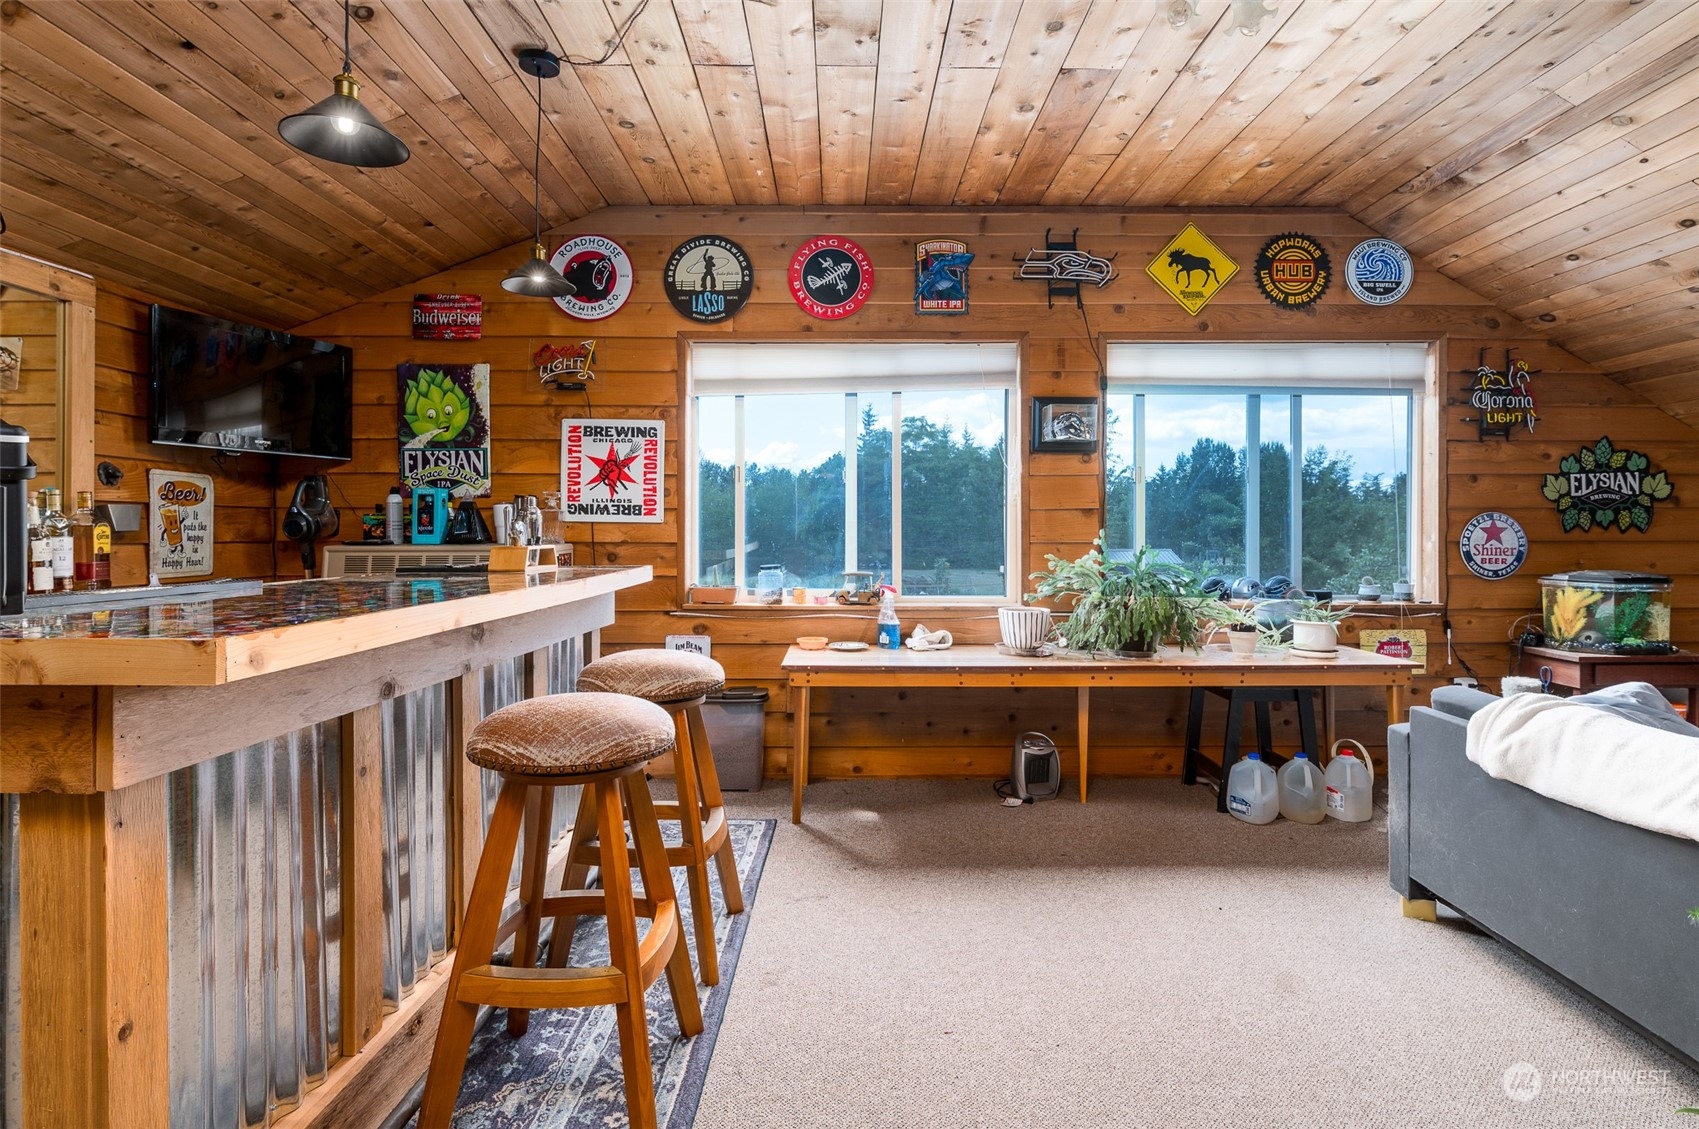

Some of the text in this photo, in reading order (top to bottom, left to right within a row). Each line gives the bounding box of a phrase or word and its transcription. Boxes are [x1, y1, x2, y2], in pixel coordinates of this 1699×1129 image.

[558, 238, 622, 259] ROADHOUSE
[794, 239, 869, 270] FLYING FISH
[920, 242, 964, 256] SHARKINATOR
[1265, 237, 1322, 258] HOPWORKS
[1352, 246, 1366, 261] MAUI
[1366, 241, 1400, 253] BREWING
[667, 254, 681, 282] GREAT
[681, 239, 711, 254] DIVIDE
[714, 239, 747, 267] BREWING
[1273, 262, 1314, 279] HUB
[1260, 269, 1327, 304] URBAN BREWERY
[1358, 288, 1402, 302] ISLAND BREWED
[560, 293, 622, 312] BREWING CO.
[692, 291, 725, 315] LASSO
[793, 281, 855, 315] BREWING
[923, 300, 962, 308] WHITE IPA
[413, 308, 481, 326] Budweiser
[540, 357, 584, 378] LIGHT
[1472, 390, 1534, 412] Corona
[1486, 412, 1523, 423] LIGHT
[582, 425, 658, 438] BREWING
[404, 450, 484, 477] ELYSIAN
[567, 425, 582, 502] REVOLUTION
[410, 465, 482, 487] Space Dust
[437, 480, 452, 488] IPA
[642, 439, 658, 517] REVOLUTION
[1569, 471, 1640, 497] ELYSIAN
[160, 481, 206, 502] Beer!
[1590, 493, 1621, 501] BREWING
[193, 511, 199, 520] It
[567, 503, 642, 516] BREWING
[183, 523, 208, 533] puts the
[1462, 513, 1527, 553] SPOETZL BREWERY
[186, 533, 204, 544] happy
[1472, 543, 1517, 557] Shiner
[161, 556, 204, 569] Happy Hour!
[1468, 560, 1519, 578] SHINER, TEXAS
[1480, 557, 1508, 565] BEER
[685, 640, 703, 654] BEAM
